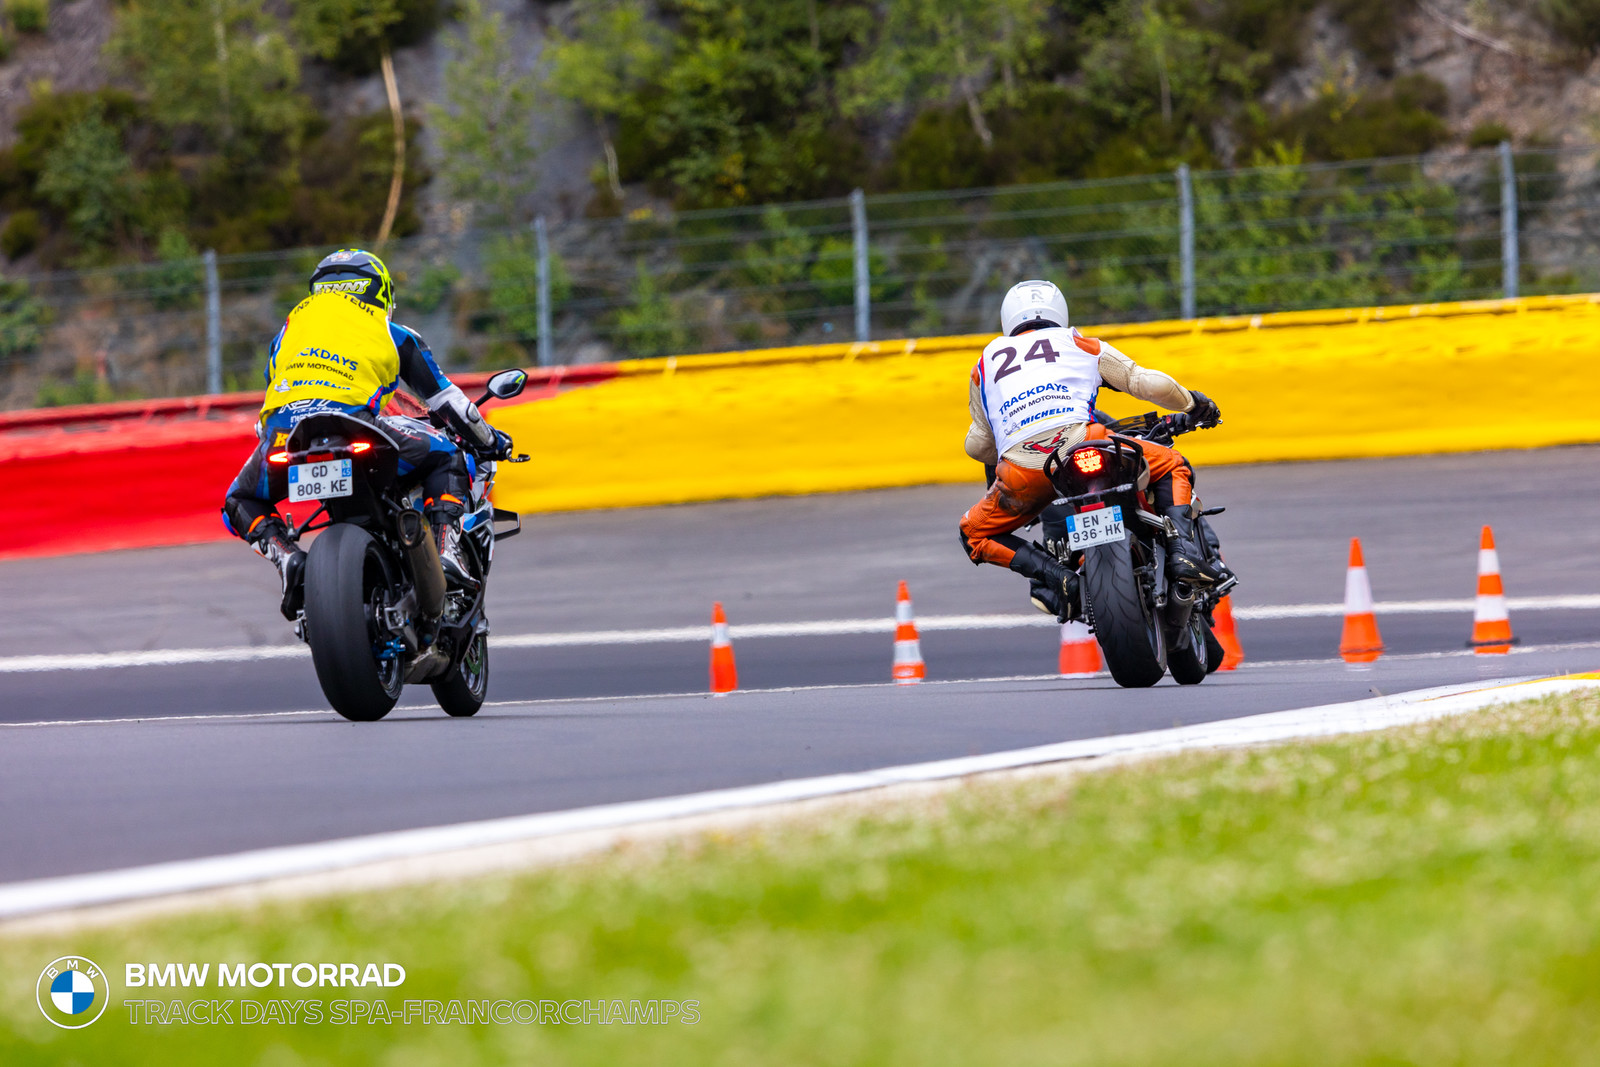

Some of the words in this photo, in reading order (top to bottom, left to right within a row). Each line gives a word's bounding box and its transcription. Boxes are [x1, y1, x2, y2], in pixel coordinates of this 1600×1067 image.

[991, 338, 1060, 384] 24
[999, 383, 1069, 415] TRACKDAYS
[1008, 404, 1027, 418] BMW
[1028, 394, 1072, 407] MOTORRAD
[1020, 407, 1075, 426] MICHELIN
[311, 465, 328, 478] GD
[1082, 514, 1099, 528] EN
